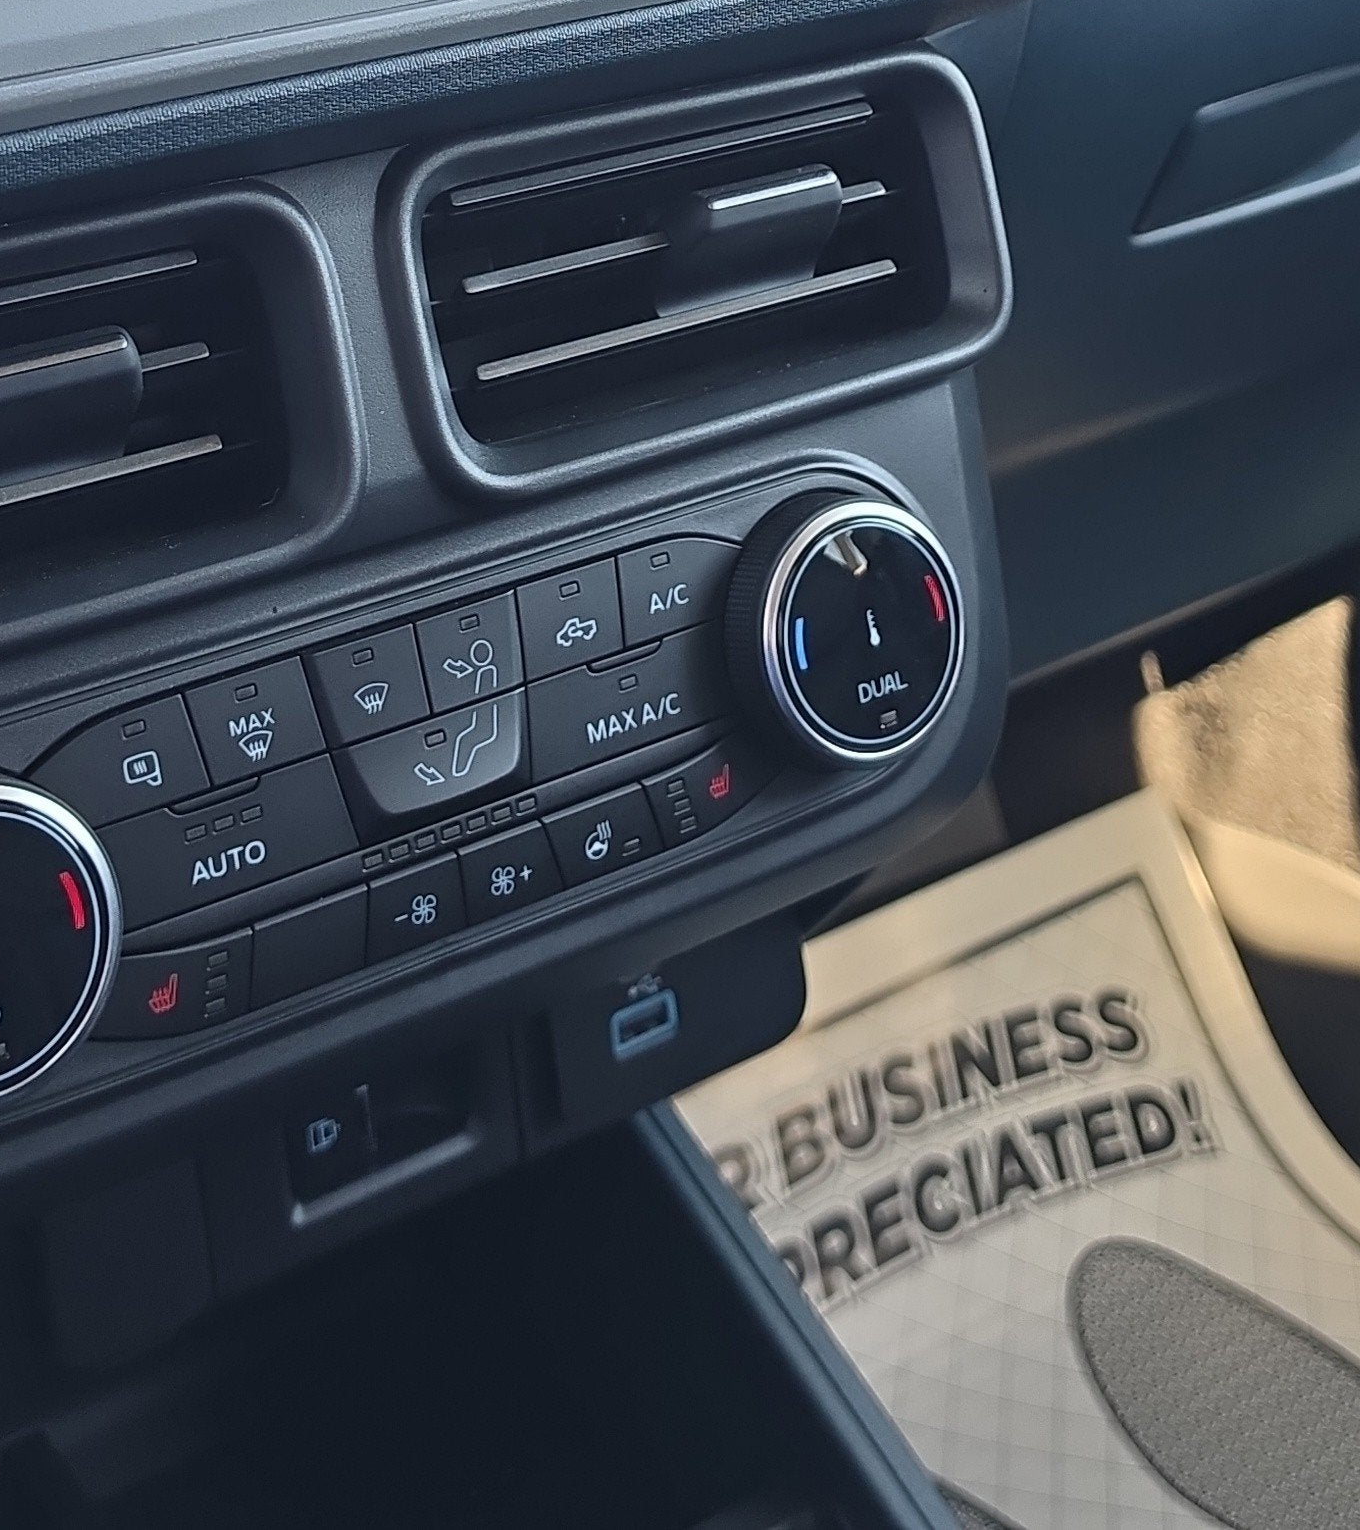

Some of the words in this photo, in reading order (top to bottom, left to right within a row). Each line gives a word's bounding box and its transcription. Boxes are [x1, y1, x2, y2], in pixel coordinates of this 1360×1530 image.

[648, 583, 690, 614] A/C
[857, 670, 909, 705] DUAL
[228, 707, 276, 737] MAX
[586, 708, 638, 744] MAX
[641, 693, 682, 725] A/C
[191, 840, 267, 886] AUTO
[776, 988, 1142, 1186] BUSINESS
